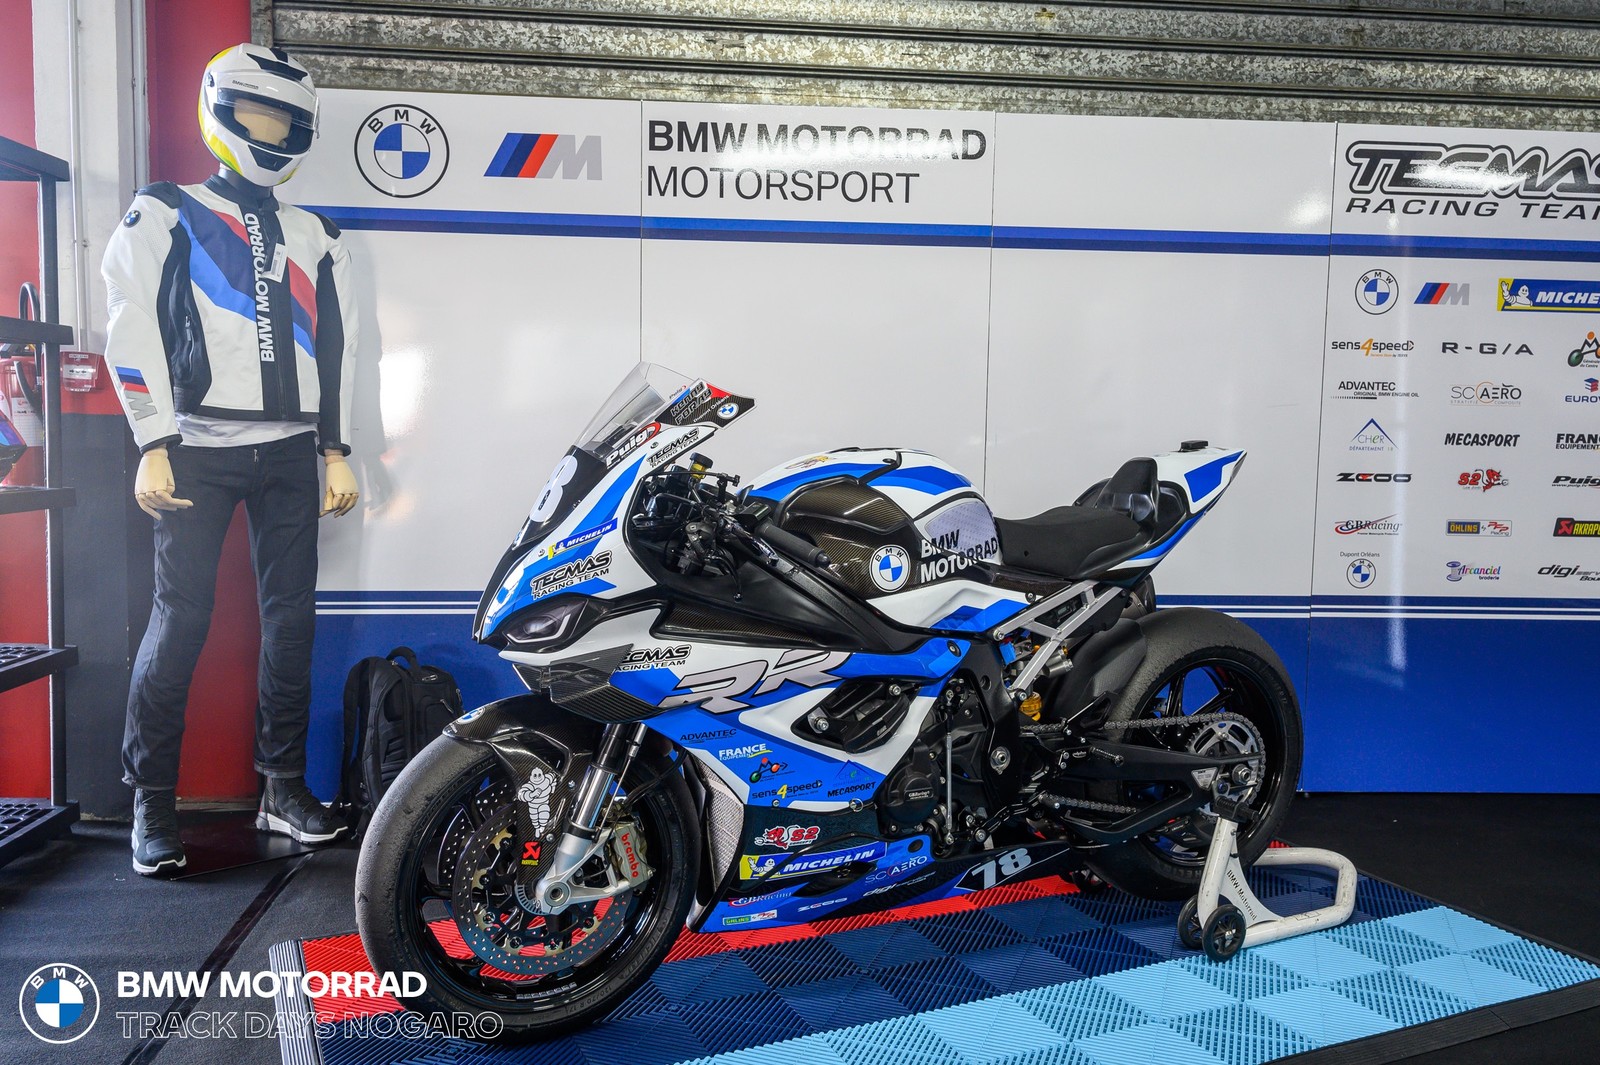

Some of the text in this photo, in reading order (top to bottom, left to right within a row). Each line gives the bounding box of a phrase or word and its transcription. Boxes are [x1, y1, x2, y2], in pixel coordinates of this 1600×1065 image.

[368, 109, 437, 134] BMW
[649, 120, 987, 160] BMW MOTORRAD
[1345, 140, 1600, 200] TECMA
[648, 165, 920, 204] MOTORSPORT
[1345, 197, 1500, 217] RACING
[244, 212, 275, 362] BMW MOTORRAD
[1363, 271, 1394, 284] BMW
[1535, 291, 1600, 304] MICHE
[1338, 381, 1396, 391] ADVANTEC
[606, 429, 648, 466] Puig
[646, 427, 700, 463] TECMAS
[1444, 433, 1520, 447] MECASPORT
[1556, 433, 1600, 444] FRAN
[1458, 472, 1481, 485] S2
[1552, 475, 1600, 486] Puig
[567, 523, 612, 548] MICHELIN
[1345, 519, 1400, 532] GBRacing
[874, 547, 905, 562] BMW
[921, 529, 960, 558] BMW
[920, 536, 998, 583] MOTORRAD
[531, 551, 612, 593] TECMAS
[533, 567, 610, 599] RACING TEAM
[621, 644, 692, 664] ECMAS
[614, 659, 686, 673] ACING TEAM
[680, 728, 737, 741] ADVANTEC
[719, 743, 767, 758] FRANCE
[827, 781, 877, 798] MECASPORT
[791, 826, 819, 842] S2
[621, 833, 638, 879] brembo
[783, 849, 875, 873] MICHELIN
[972, 848, 1032, 891] 78
[1226, 870, 1257, 921] BMW Motorrad
